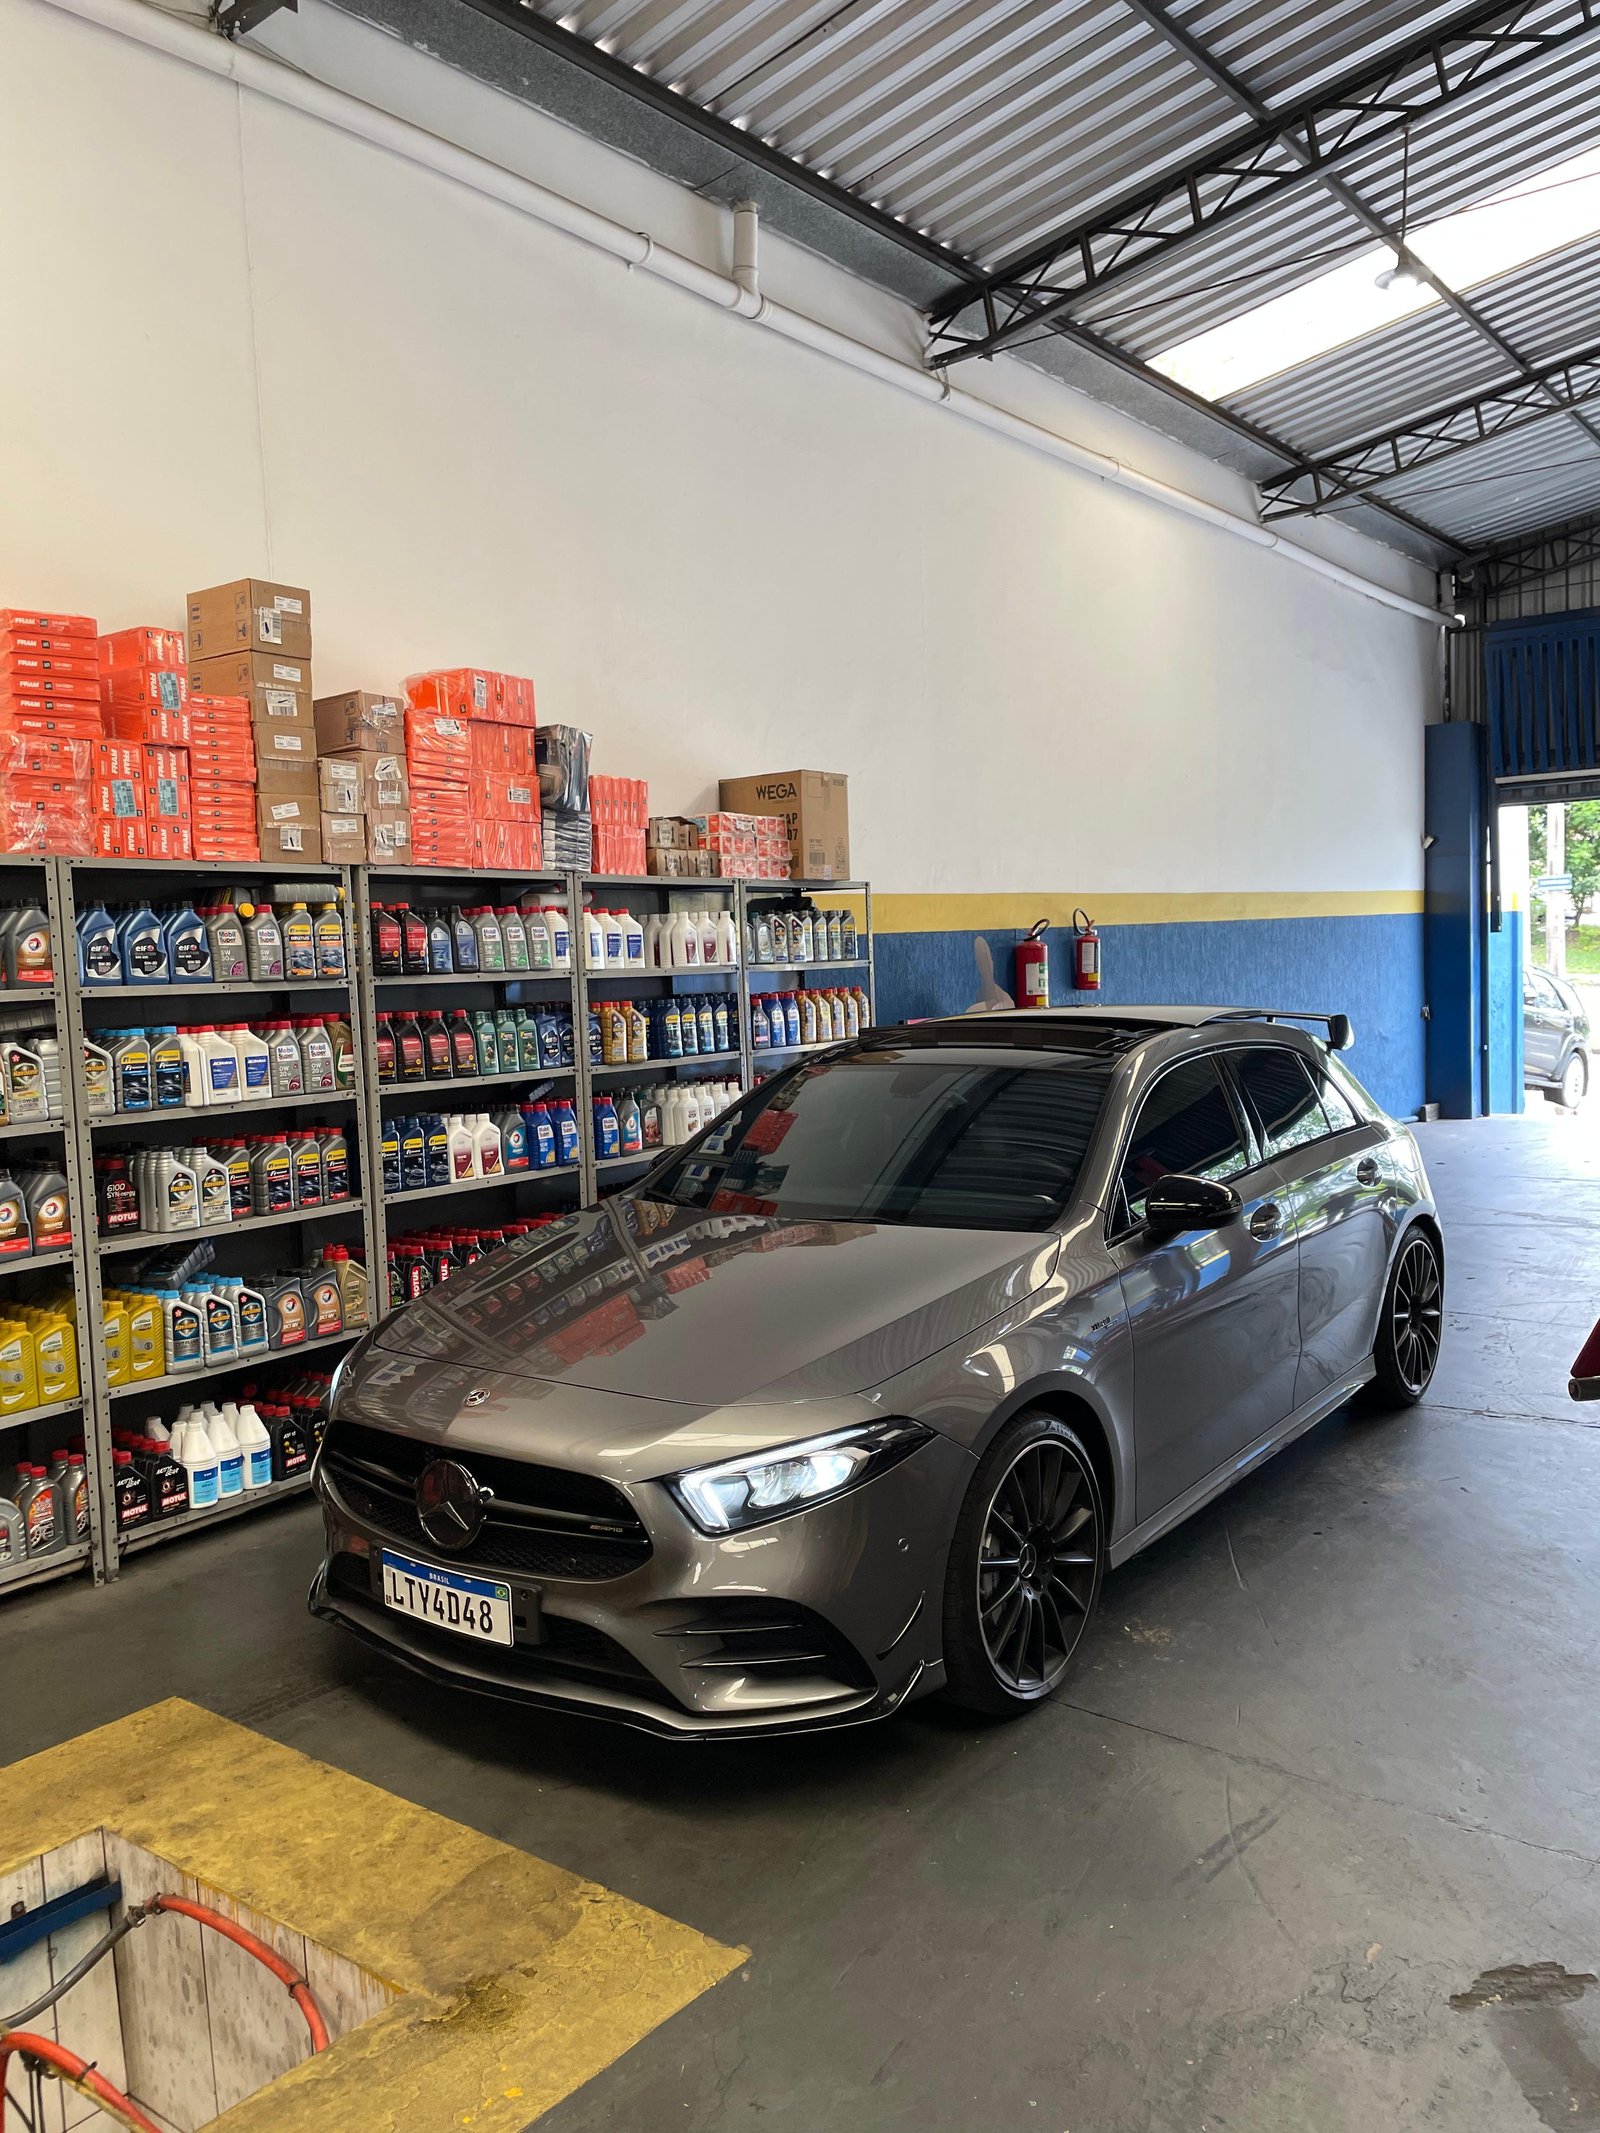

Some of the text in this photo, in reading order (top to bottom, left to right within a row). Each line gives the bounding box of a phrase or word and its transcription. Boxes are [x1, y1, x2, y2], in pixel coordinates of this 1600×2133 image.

[15, 617, 35, 625] FRAM
[17, 639, 37, 647] FRAM
[177, 639, 185, 664] FRAM
[18, 659, 38, 667] FRAM
[20, 680, 39, 688] FRAM
[22, 720, 42, 728] FRAM
[122, 749, 130, 775] FRAM
[169, 752, 177, 778] FRAM
[756, 783, 797, 800] WEGA
[101, 786, 109, 812] FRAM
[103, 825, 111, 851] FRAM
[127, 826, 135, 852] FRAM
[107, 1183, 125, 1191] 6100
[109, 1212, 138, 1222] MOTUL
[286, 1454, 307, 1468] MOTUL
[162, 1493, 187, 1507] MOTUL
[122, 1504, 148, 1519] MOTUL
[429, 1572, 450, 1585] BRASIL
[386, 1594, 392, 1605] BR
[392, 1571, 493, 1633] LTY4D48
